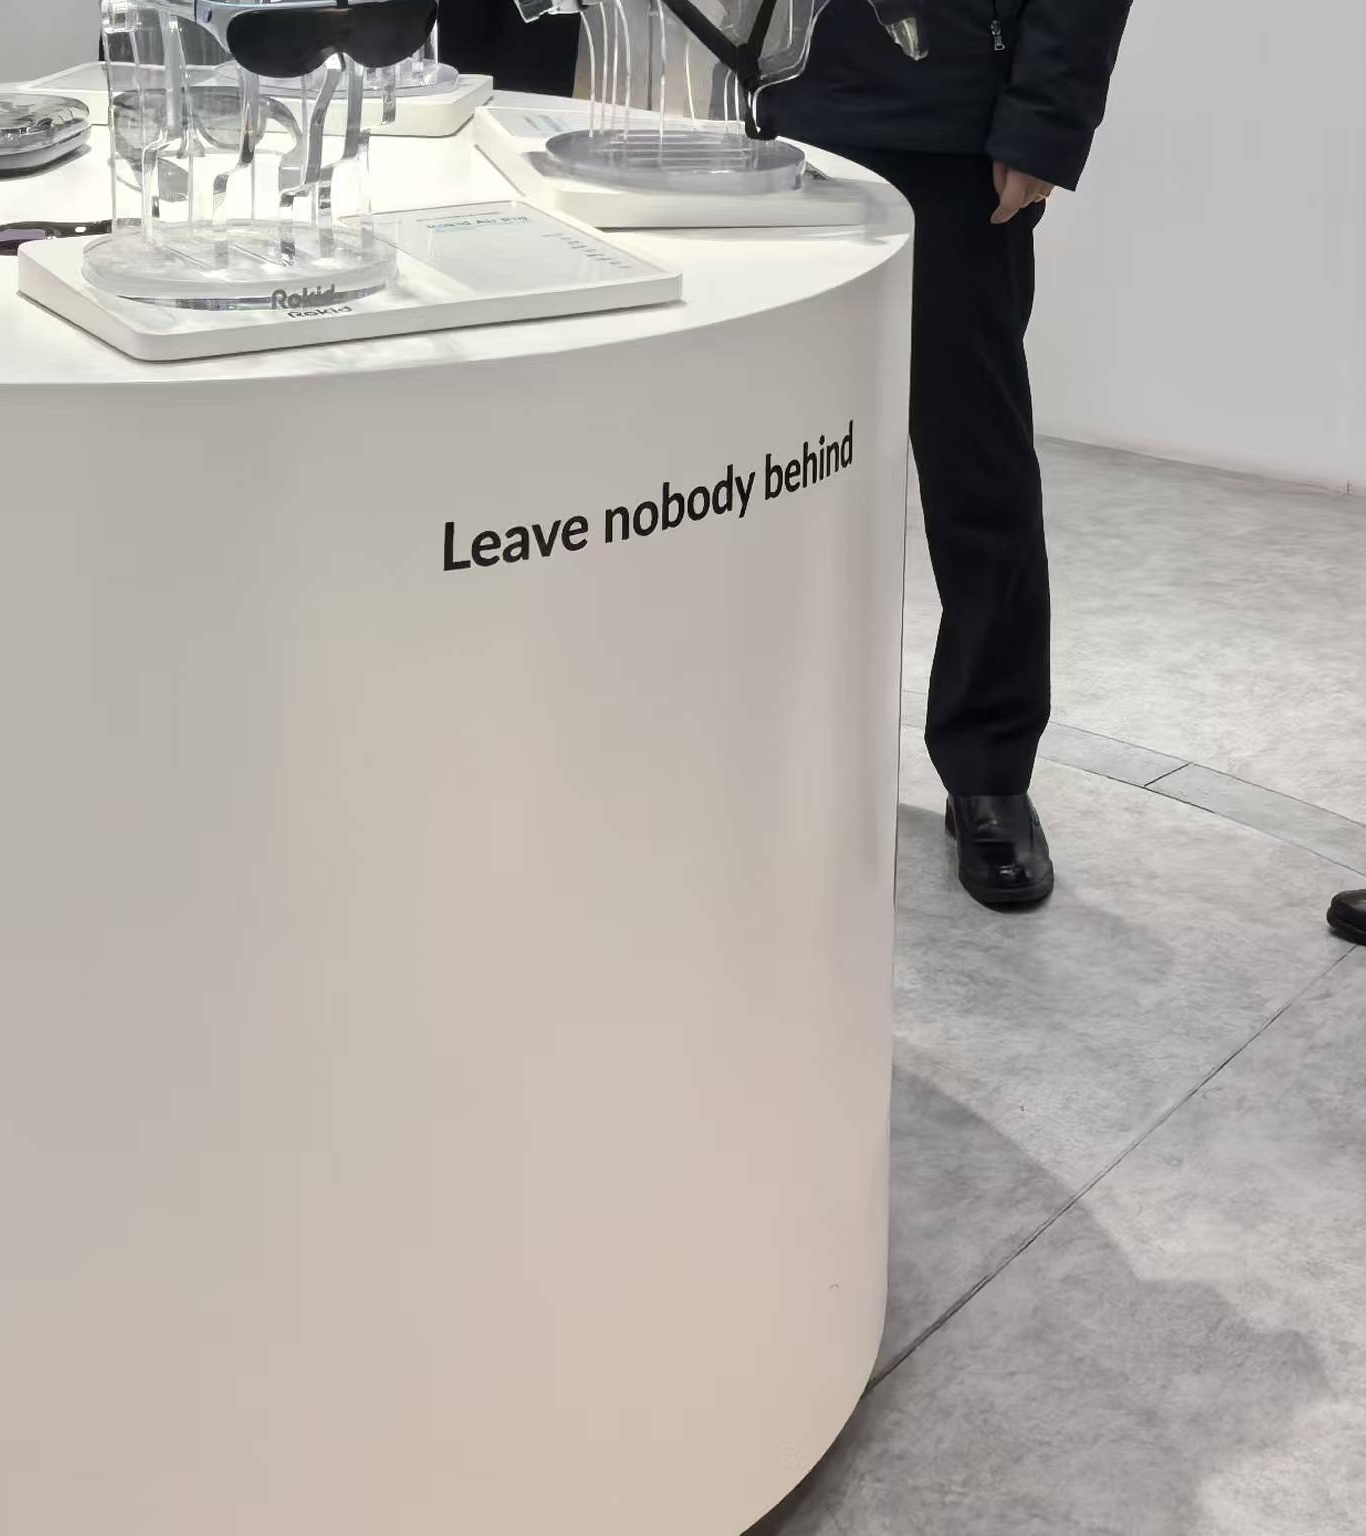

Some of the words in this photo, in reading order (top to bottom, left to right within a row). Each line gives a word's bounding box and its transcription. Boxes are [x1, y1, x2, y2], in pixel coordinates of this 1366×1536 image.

[272, 284, 335, 309] Rokid
[444, 515, 589, 571] Leave
[605, 464, 756, 542] nobody
[764, 420, 854, 500] behind
